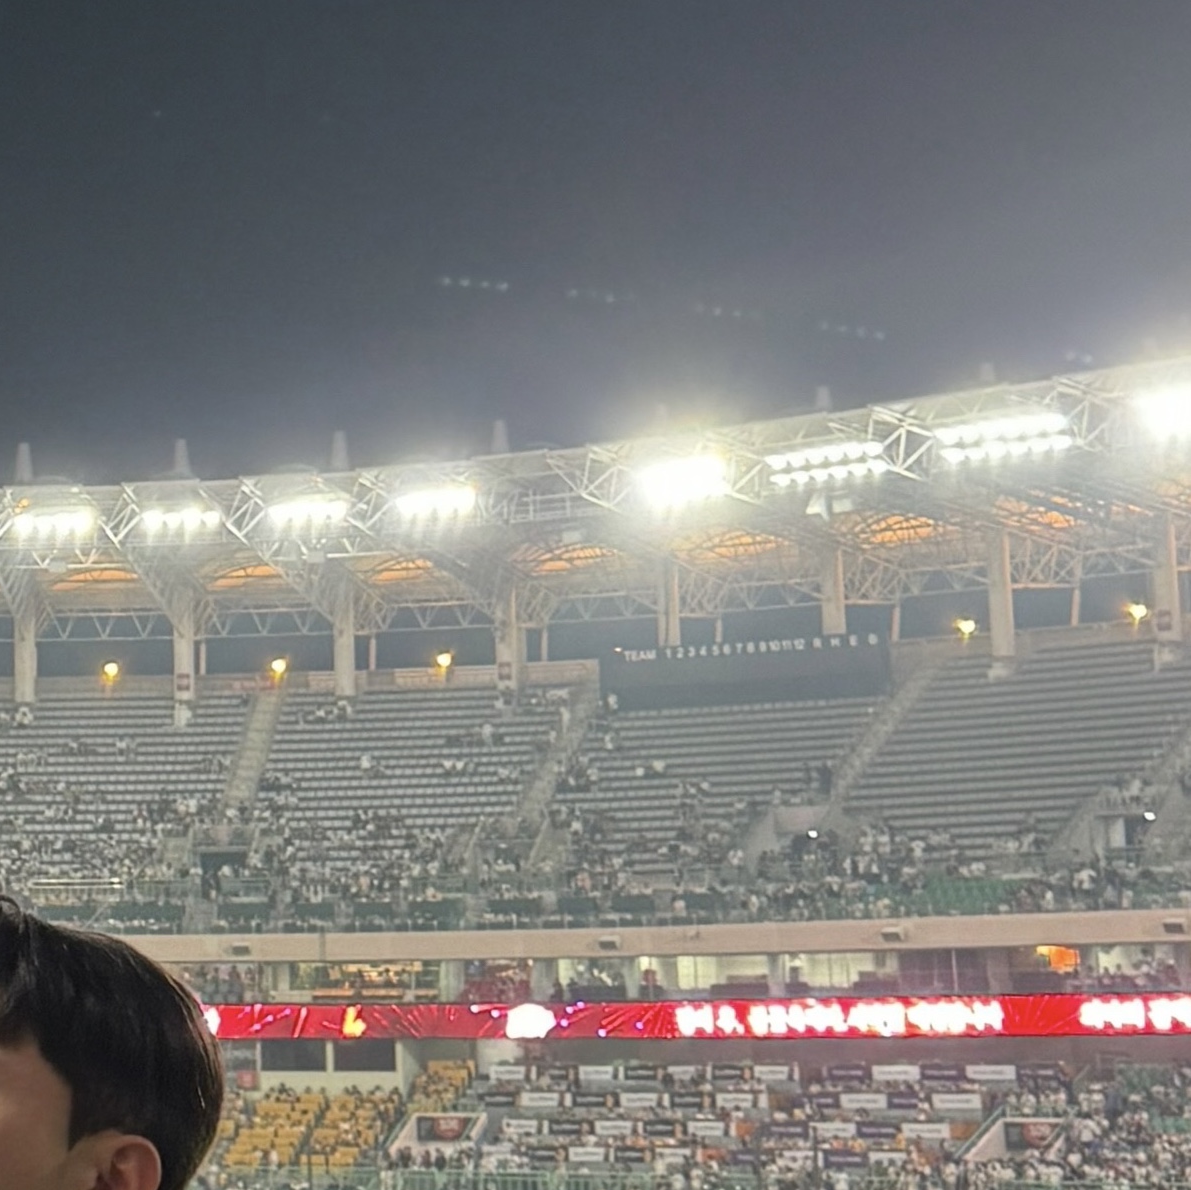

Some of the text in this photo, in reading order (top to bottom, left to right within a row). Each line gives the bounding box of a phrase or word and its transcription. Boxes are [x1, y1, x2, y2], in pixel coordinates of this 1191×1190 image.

[623, 649, 657, 662] TEAM
[676, 646, 685, 659] 2
[688, 645, 697, 657] 3
[699, 645, 708, 656] 4
[712, 644, 720, 656] 5
[723, 643, 731, 655] 6
[735, 642, 743, 654] 7
[746, 641, 755, 654] 8
